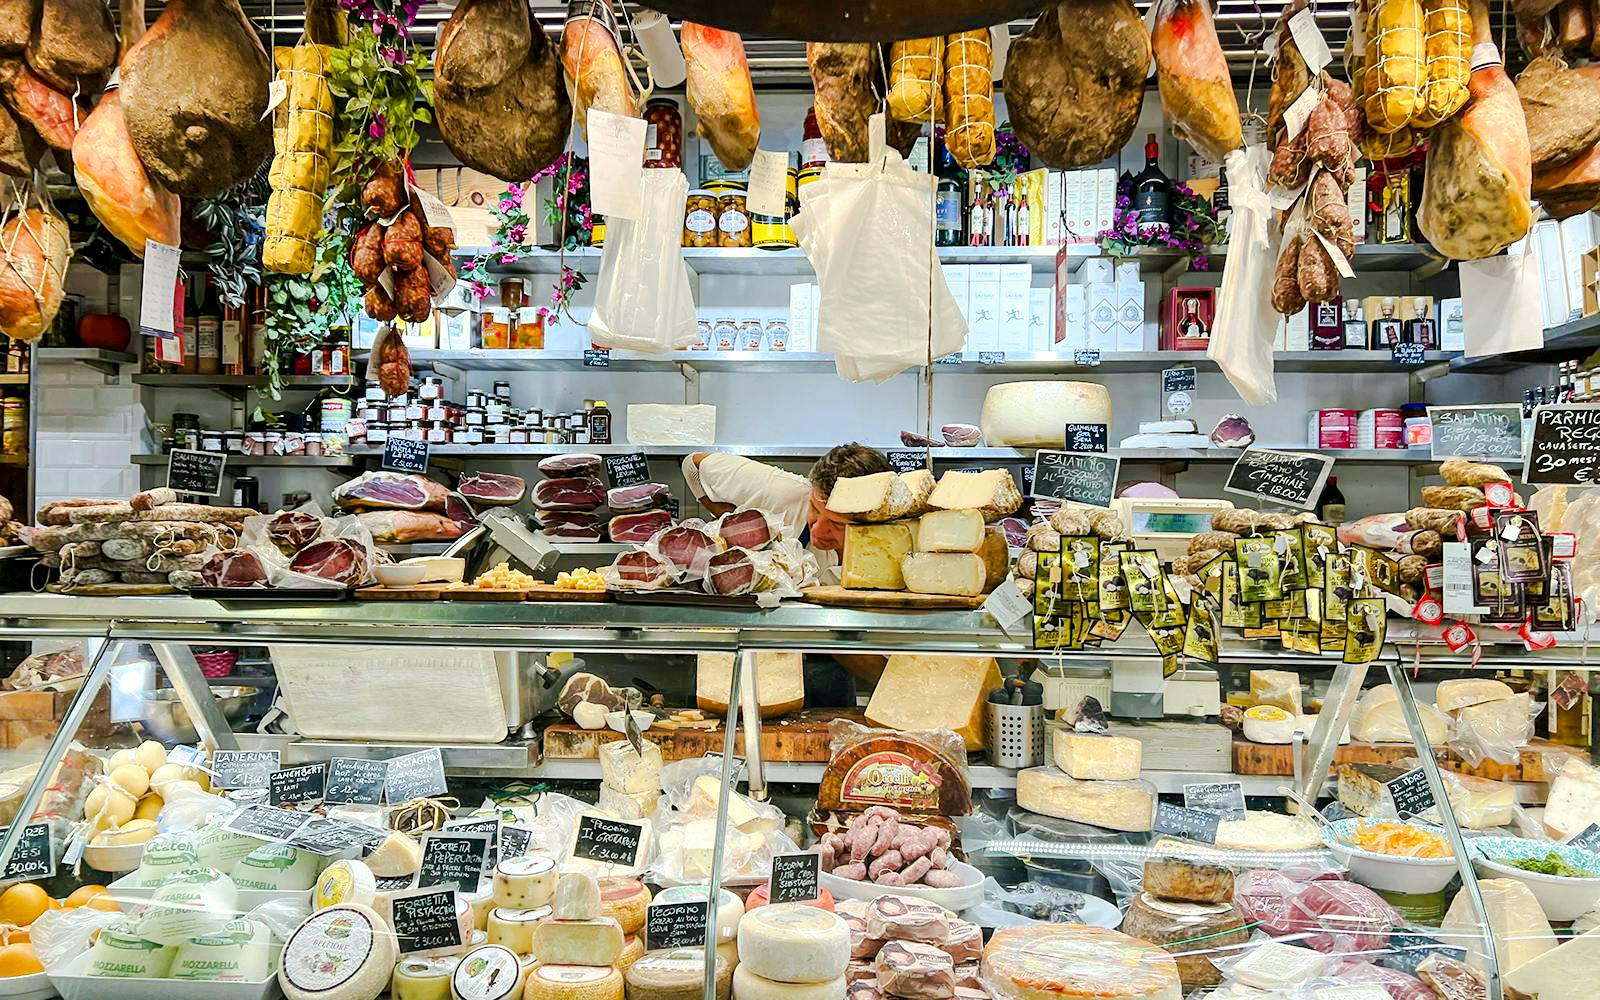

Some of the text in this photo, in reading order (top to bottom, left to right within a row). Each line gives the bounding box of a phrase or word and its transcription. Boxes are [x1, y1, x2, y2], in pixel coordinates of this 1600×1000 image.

[1536, 454, 1566, 472] 30
[1249, 470, 1305, 490] CINGHIALE
[1296, 469, 1309, 480] AL
